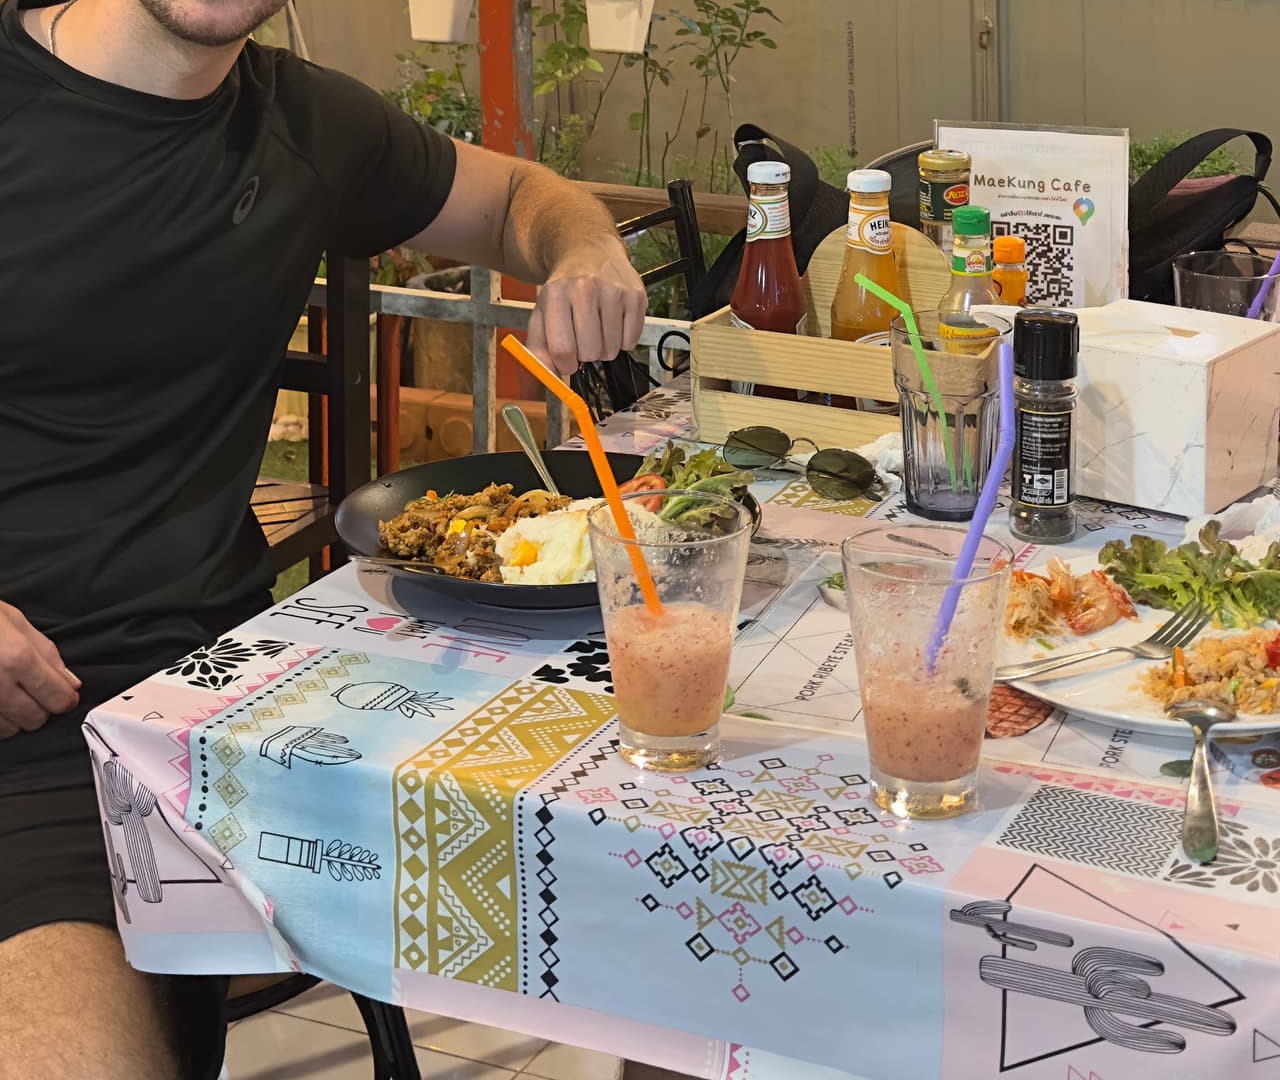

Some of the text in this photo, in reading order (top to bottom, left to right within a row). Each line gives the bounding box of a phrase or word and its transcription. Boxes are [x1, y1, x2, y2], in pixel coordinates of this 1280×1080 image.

[973, 174, 1091, 193] MaeKung Cafe
[870, 219, 890, 231] HEIN
[270, 597, 369, 629] SEE
[423, 616, 545, 663] LOVE
[794, 679, 824, 702] PORK
[812, 655, 844, 681] RIBEYE
[1099, 728, 1134, 769] PORK STE
